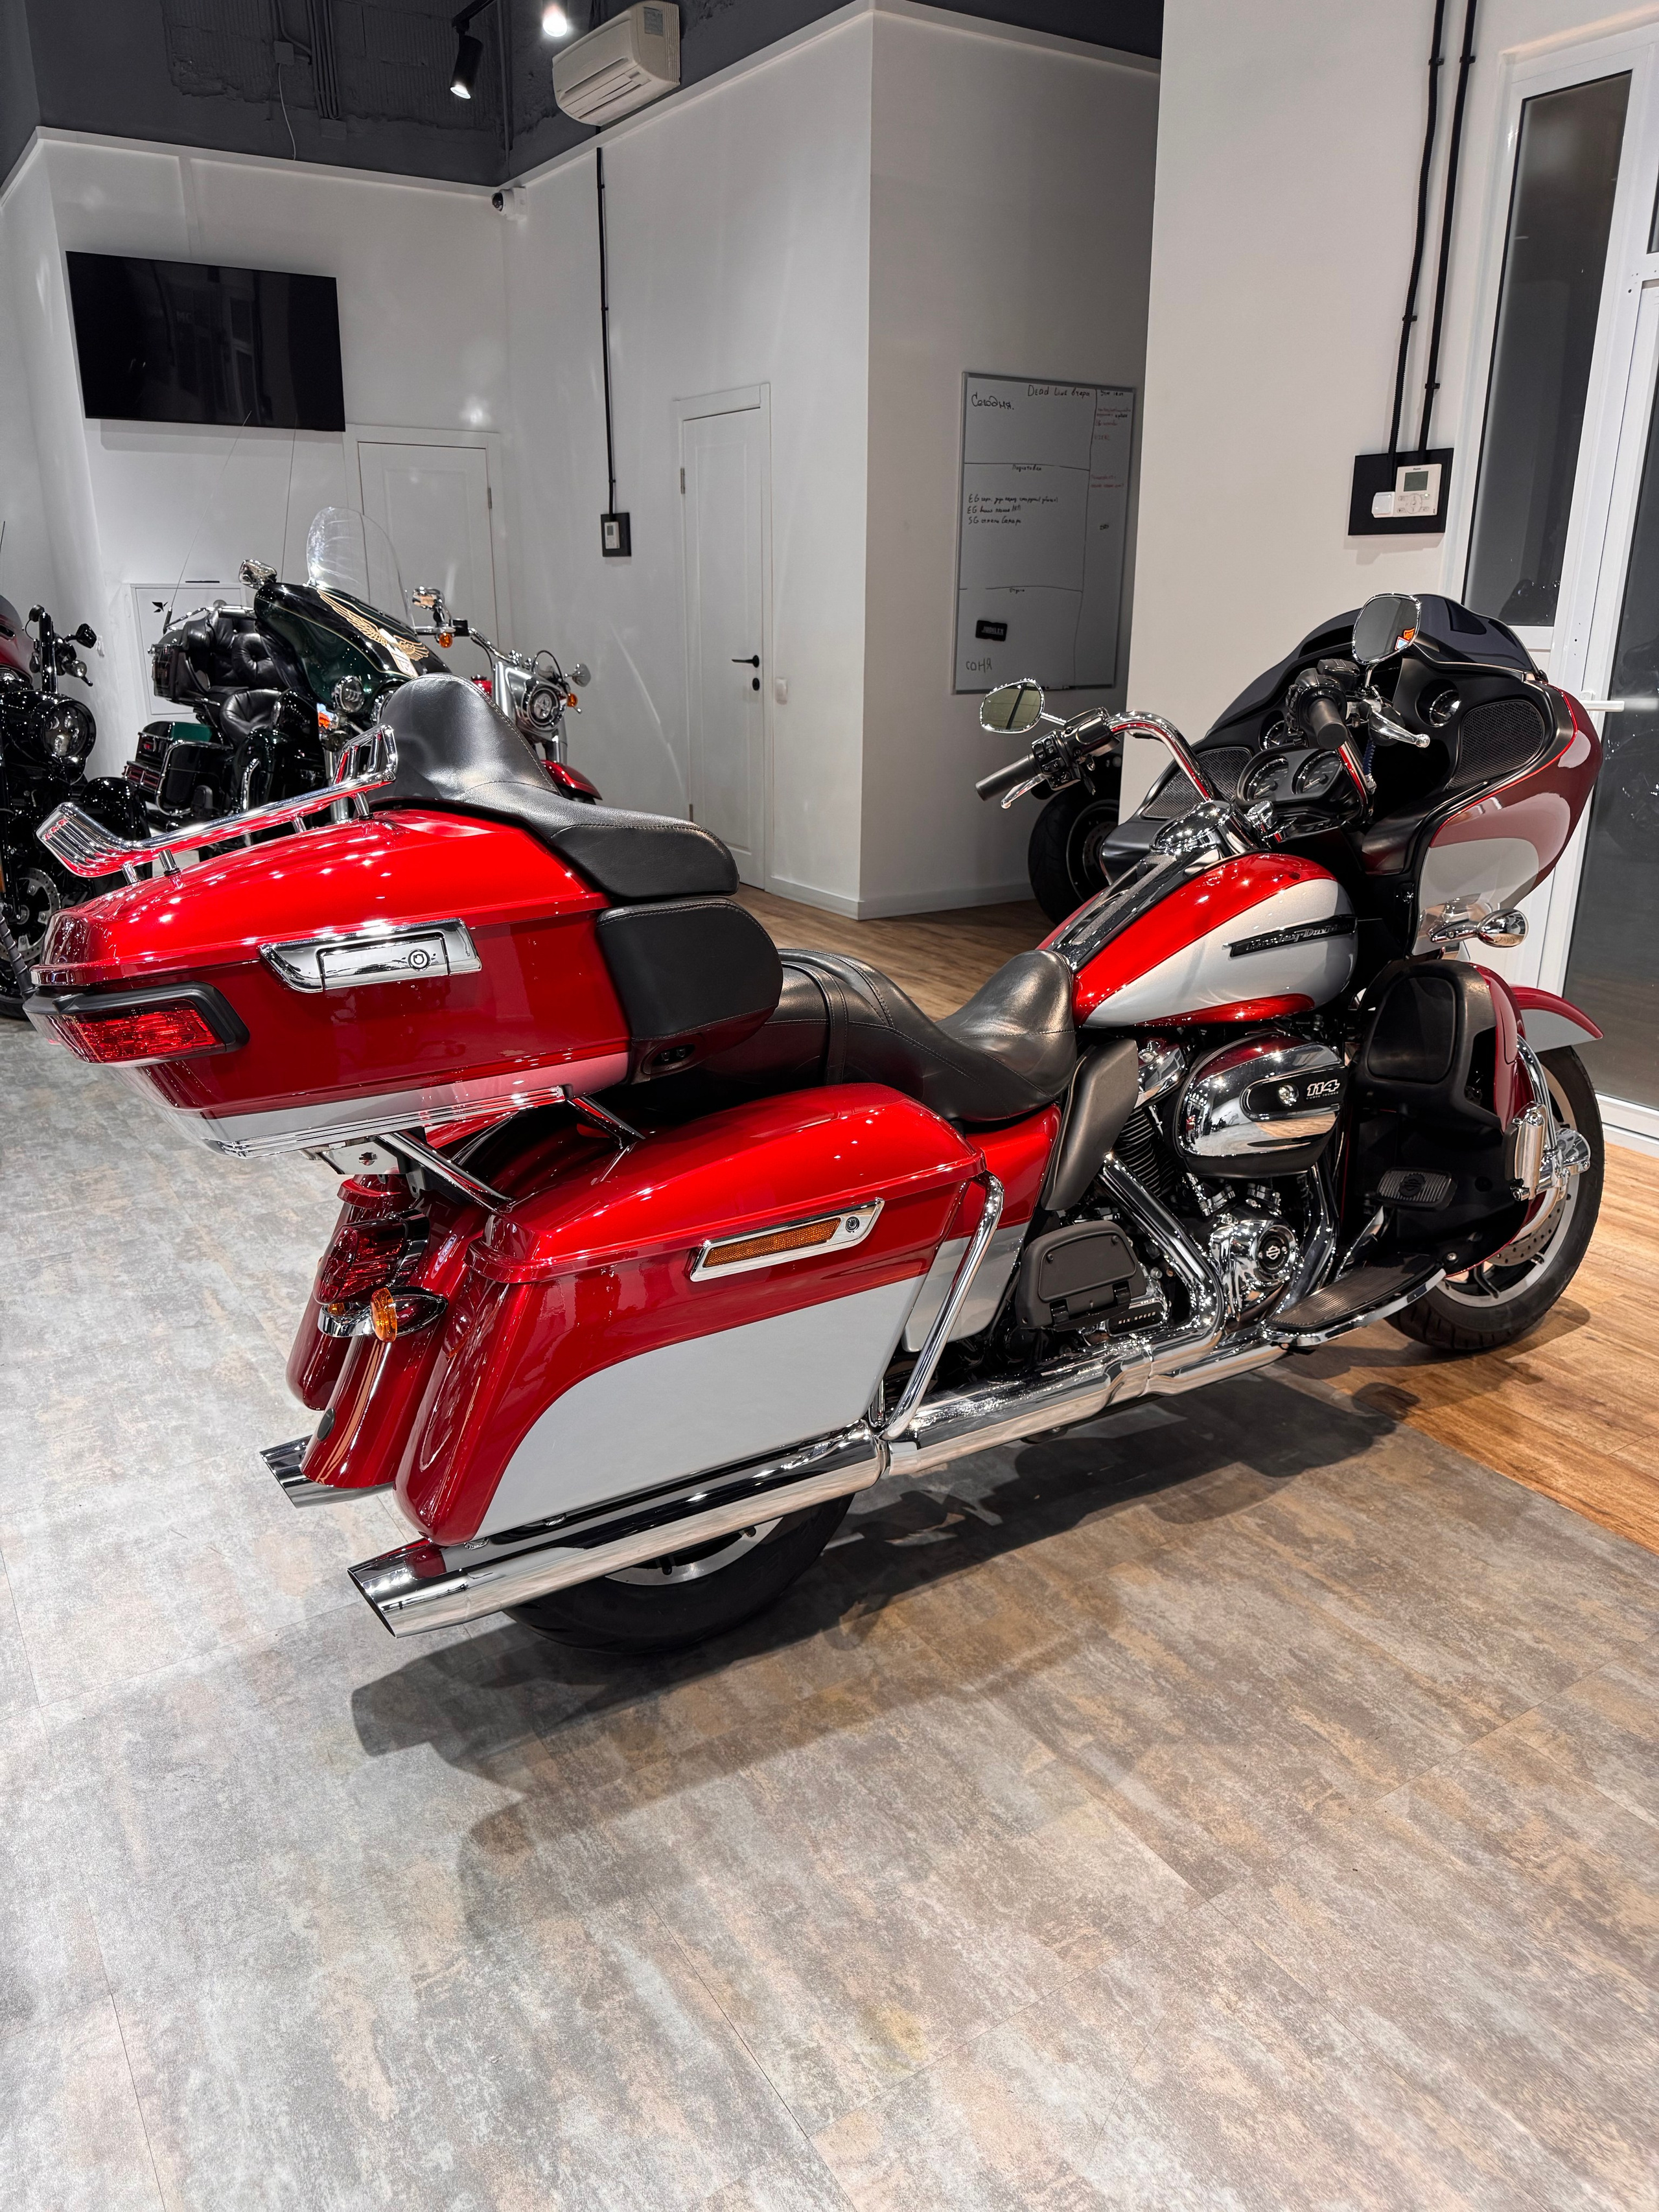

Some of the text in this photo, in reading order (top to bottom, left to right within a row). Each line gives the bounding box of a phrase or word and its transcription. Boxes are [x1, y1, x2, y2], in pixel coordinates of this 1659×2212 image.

[1028, 384, 1050, 397] Dead
[1306, 1079, 1341, 1097] 114
[1134, 1311, 1156, 1320] SPEED
